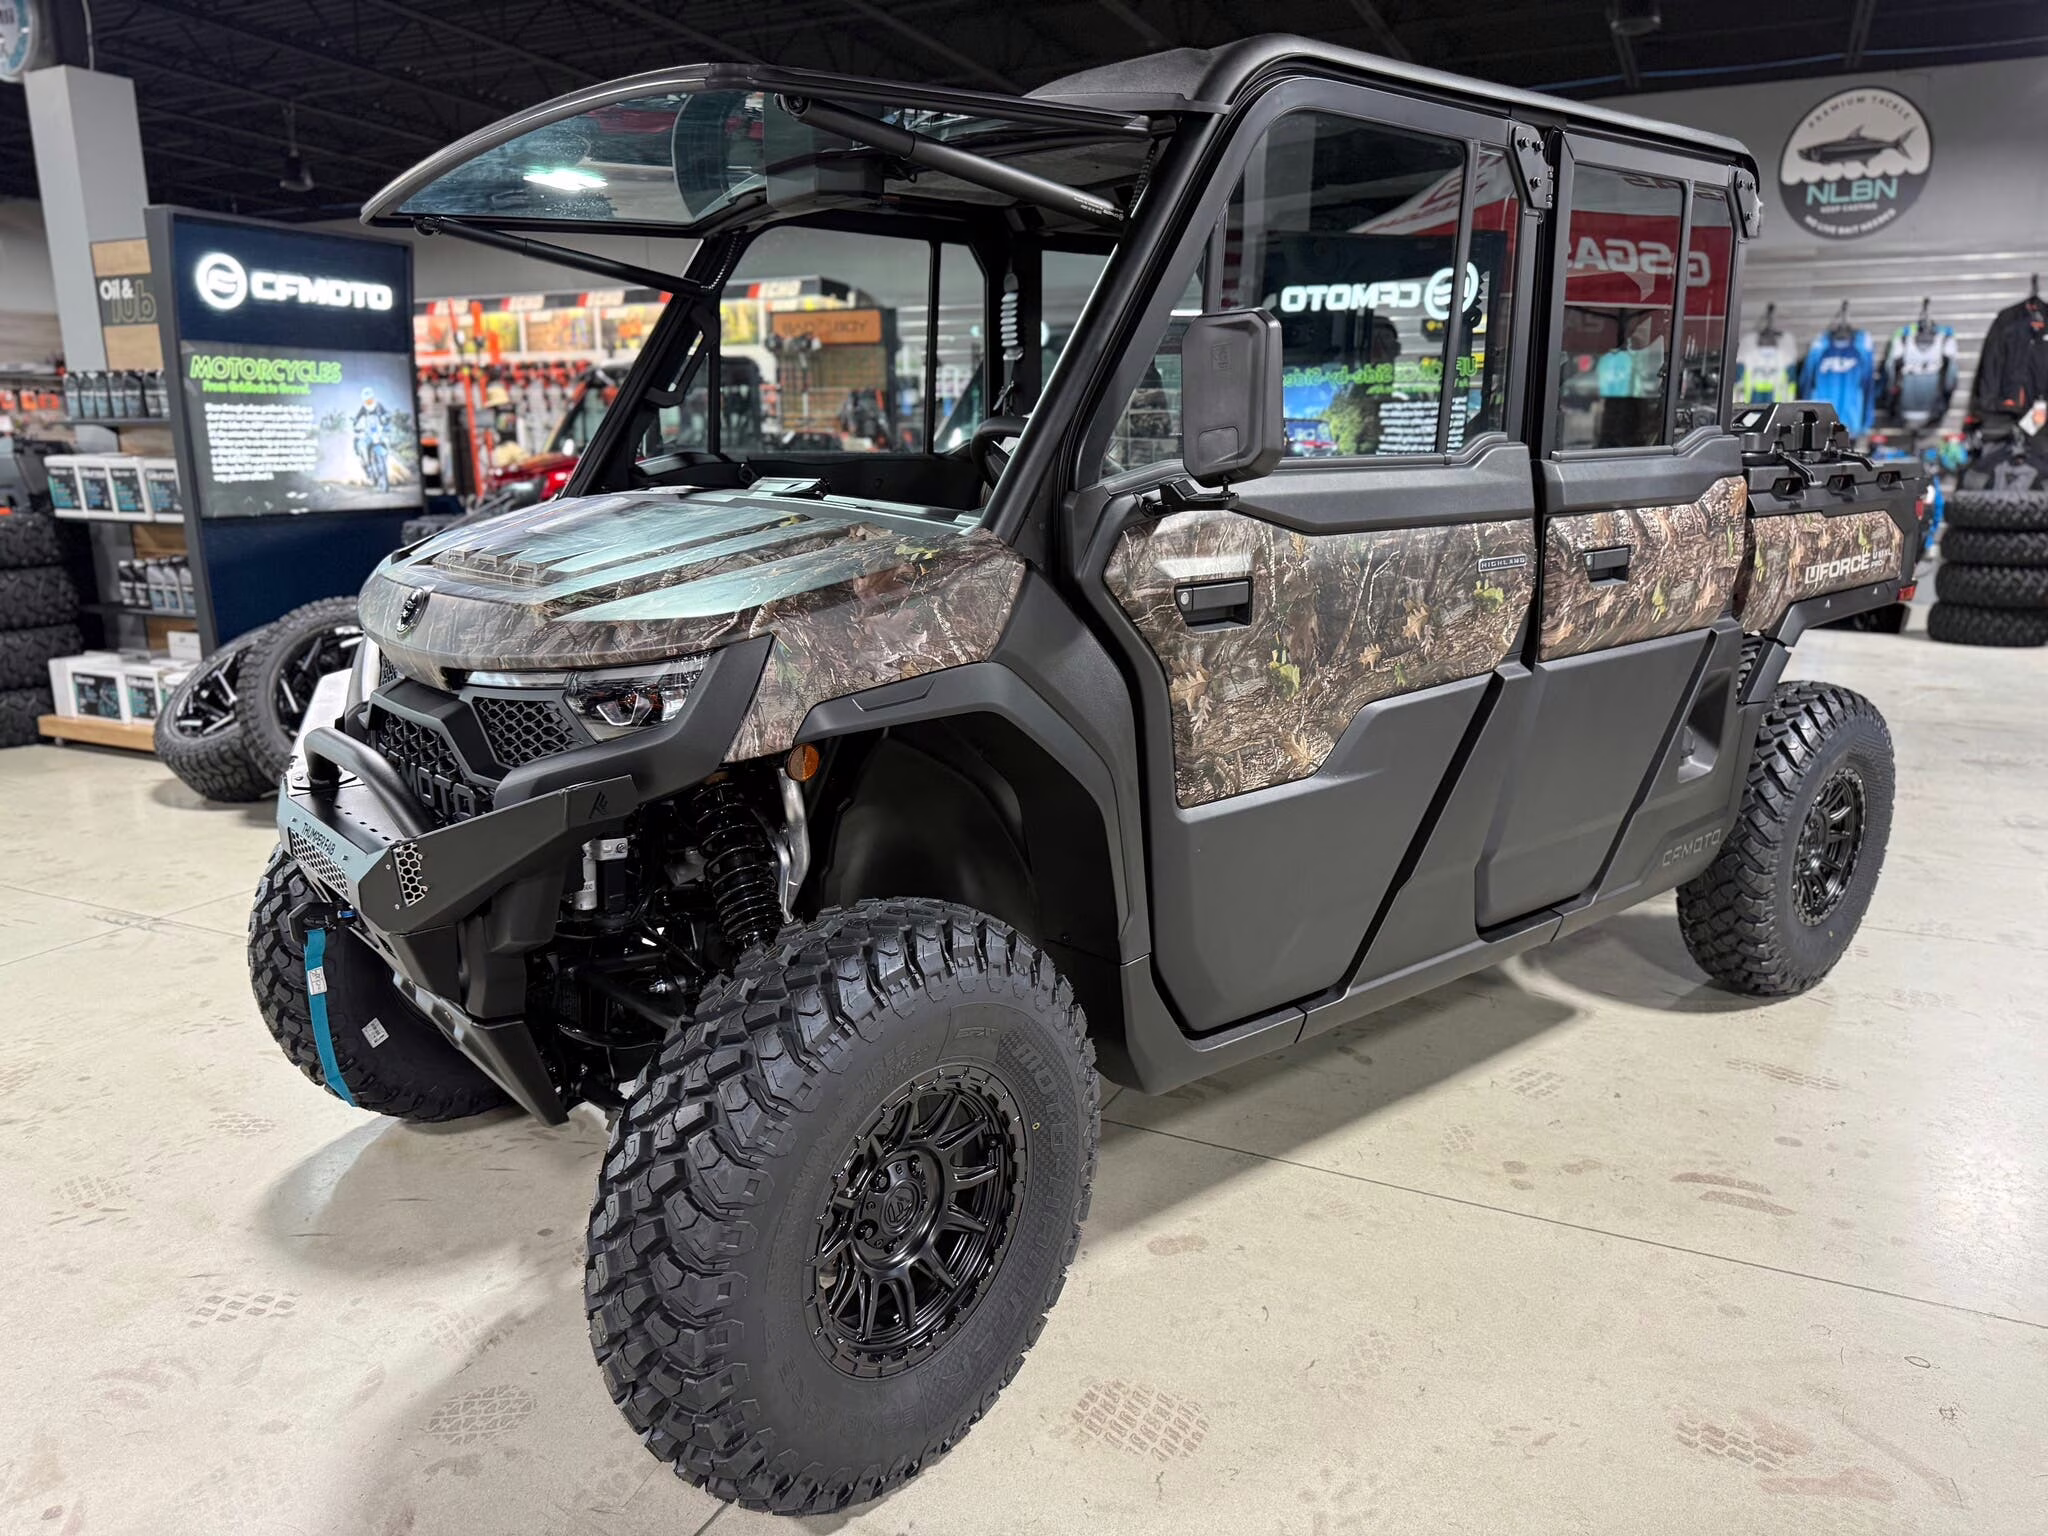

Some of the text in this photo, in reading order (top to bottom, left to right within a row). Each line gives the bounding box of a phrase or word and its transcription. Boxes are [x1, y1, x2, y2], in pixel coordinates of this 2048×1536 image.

[1806, 177, 1898, 206] NLBN
[100, 279, 121, 301] Oil
[251, 271, 393, 311] CFMOTO
[190, 354, 343, 384] MOTORCYCLES
[1481, 557, 1525, 569] HIGHLAND
[301, 822, 326, 849] THUMPER
[1662, 828, 1721, 866] CFMOTO
